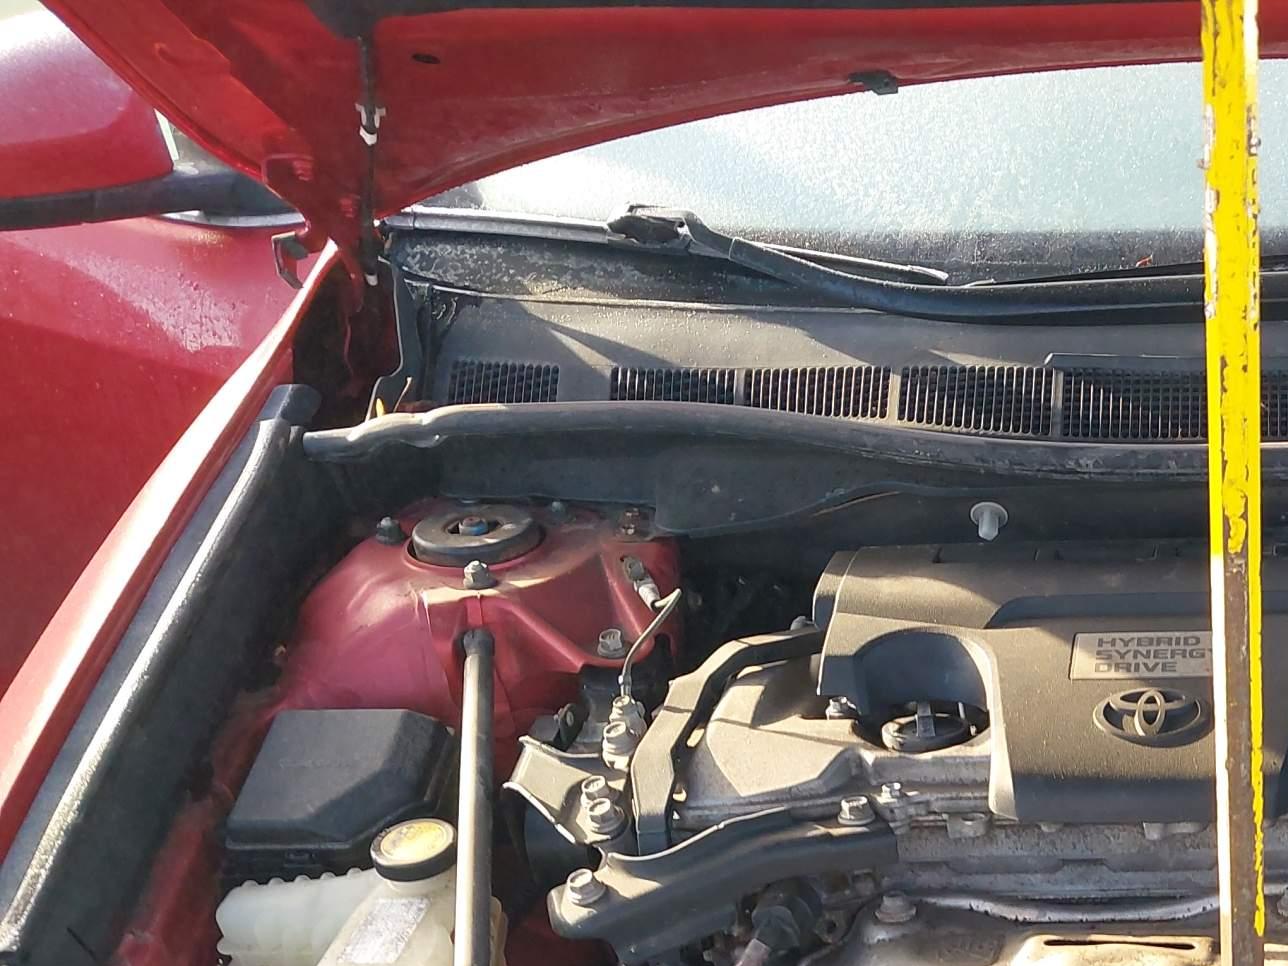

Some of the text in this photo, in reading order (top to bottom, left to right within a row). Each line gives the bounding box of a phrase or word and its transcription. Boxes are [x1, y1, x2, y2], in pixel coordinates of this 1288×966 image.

[1097, 635, 1201, 648] HYBRID
[1095, 647, 1213, 661] SYNERG
[1094, 661, 1178, 673] DRIVE
